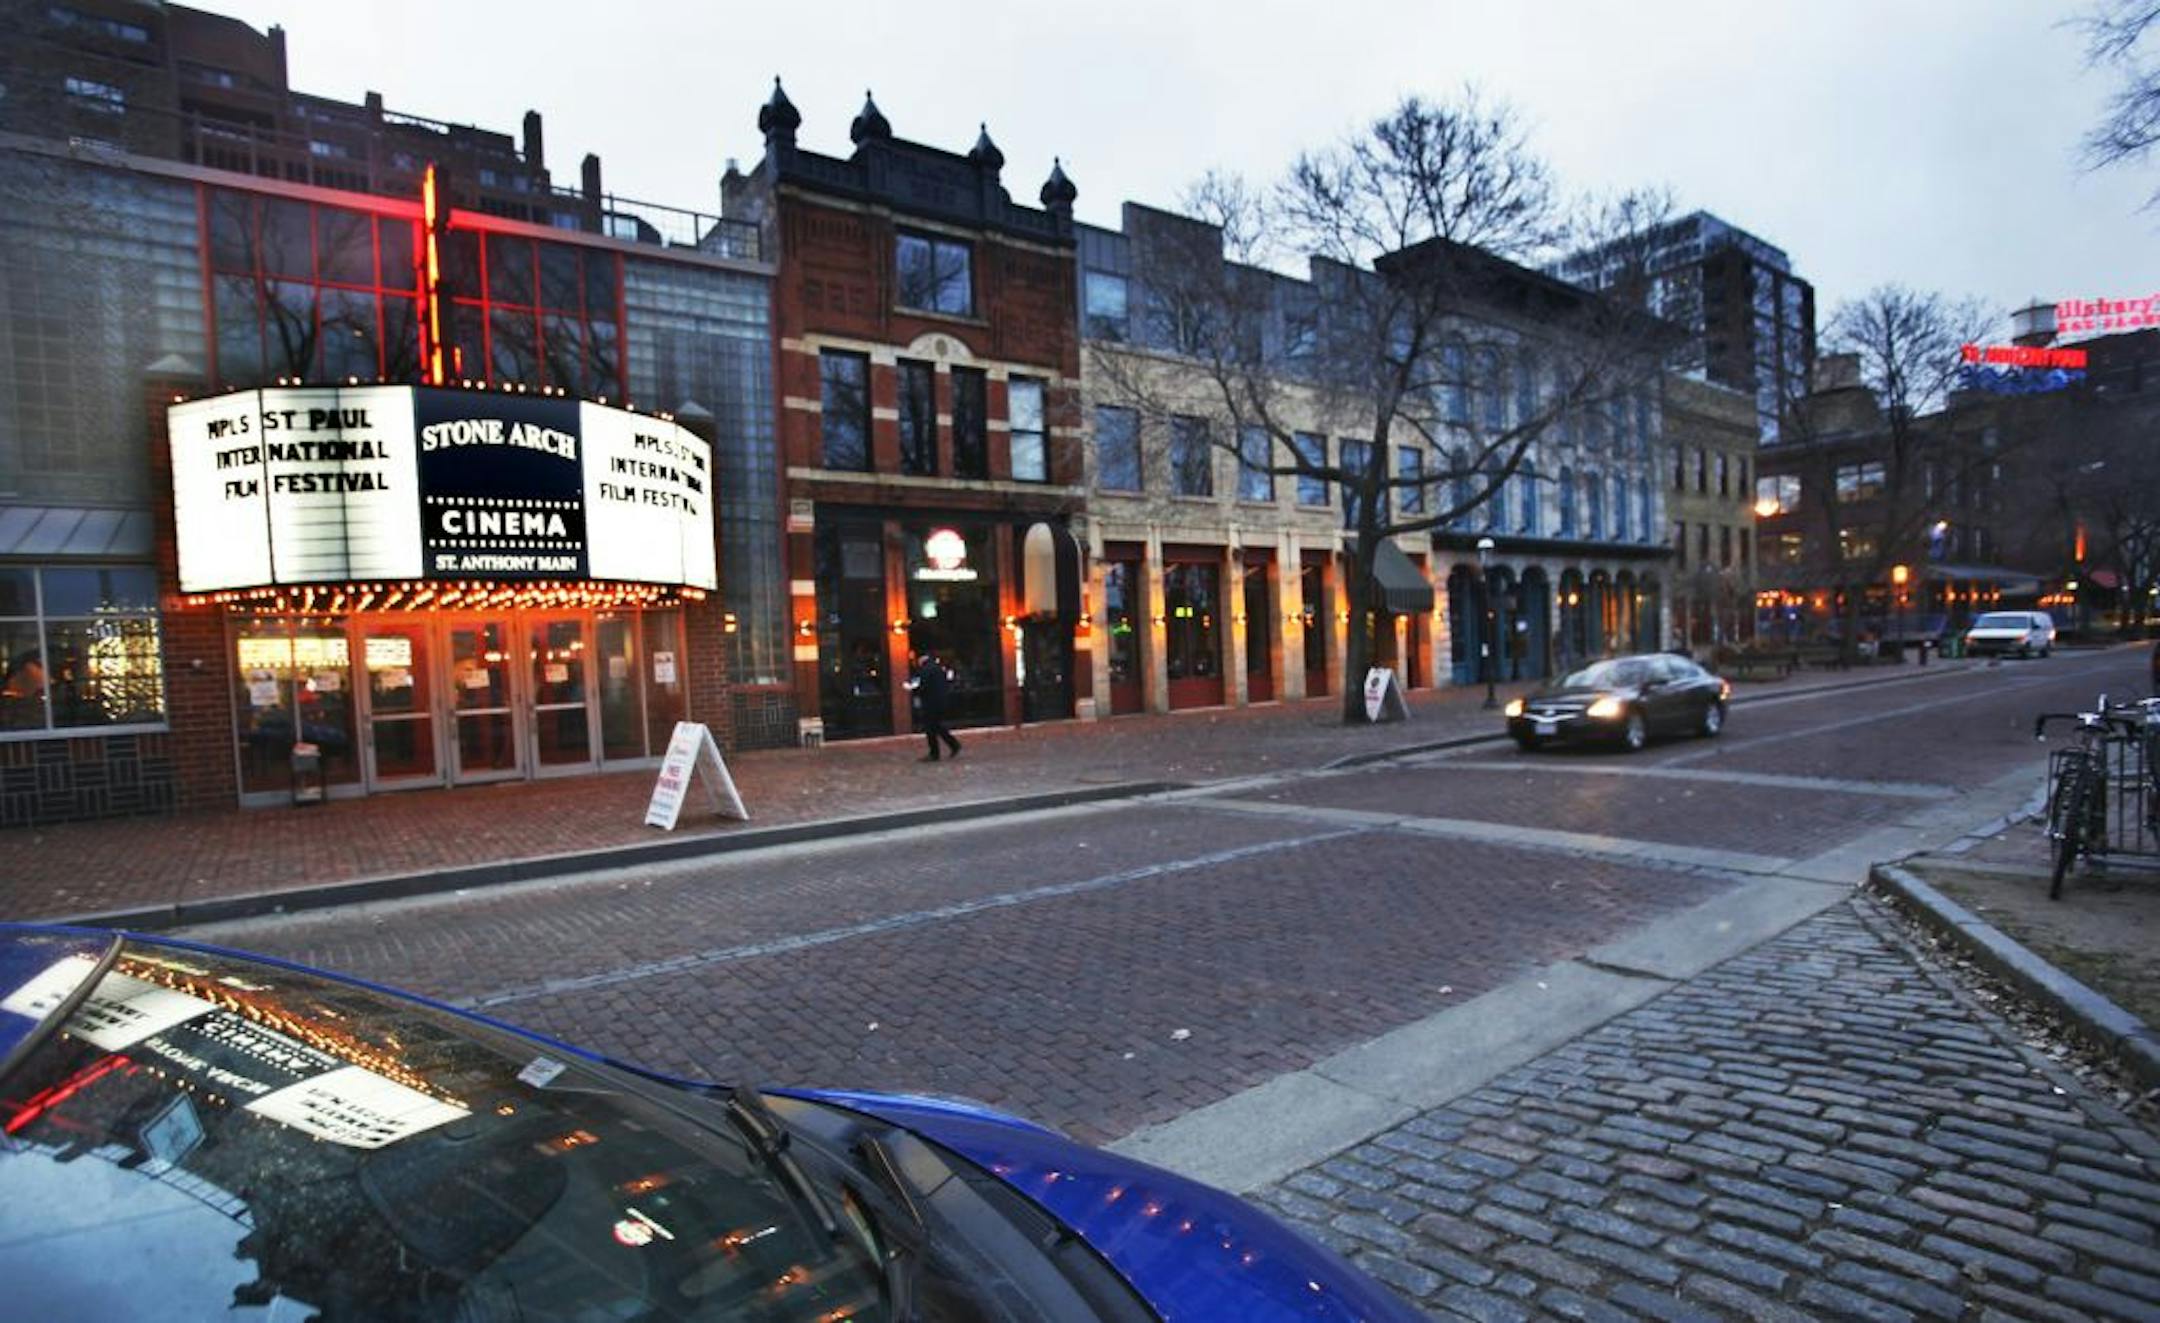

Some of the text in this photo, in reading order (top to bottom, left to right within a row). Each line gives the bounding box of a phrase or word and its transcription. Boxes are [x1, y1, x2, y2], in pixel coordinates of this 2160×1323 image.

[207, 408, 372, 440] MPLS ST PAUL
[422, 419, 576, 460] STONE ARCH
[225, 473, 389, 500] FILM FESTIVAL
[600, 483, 635, 503] FILM
[441, 510, 567, 537] CINEMA
[435, 555, 577, 571] ST. ANTHONY MAIN
